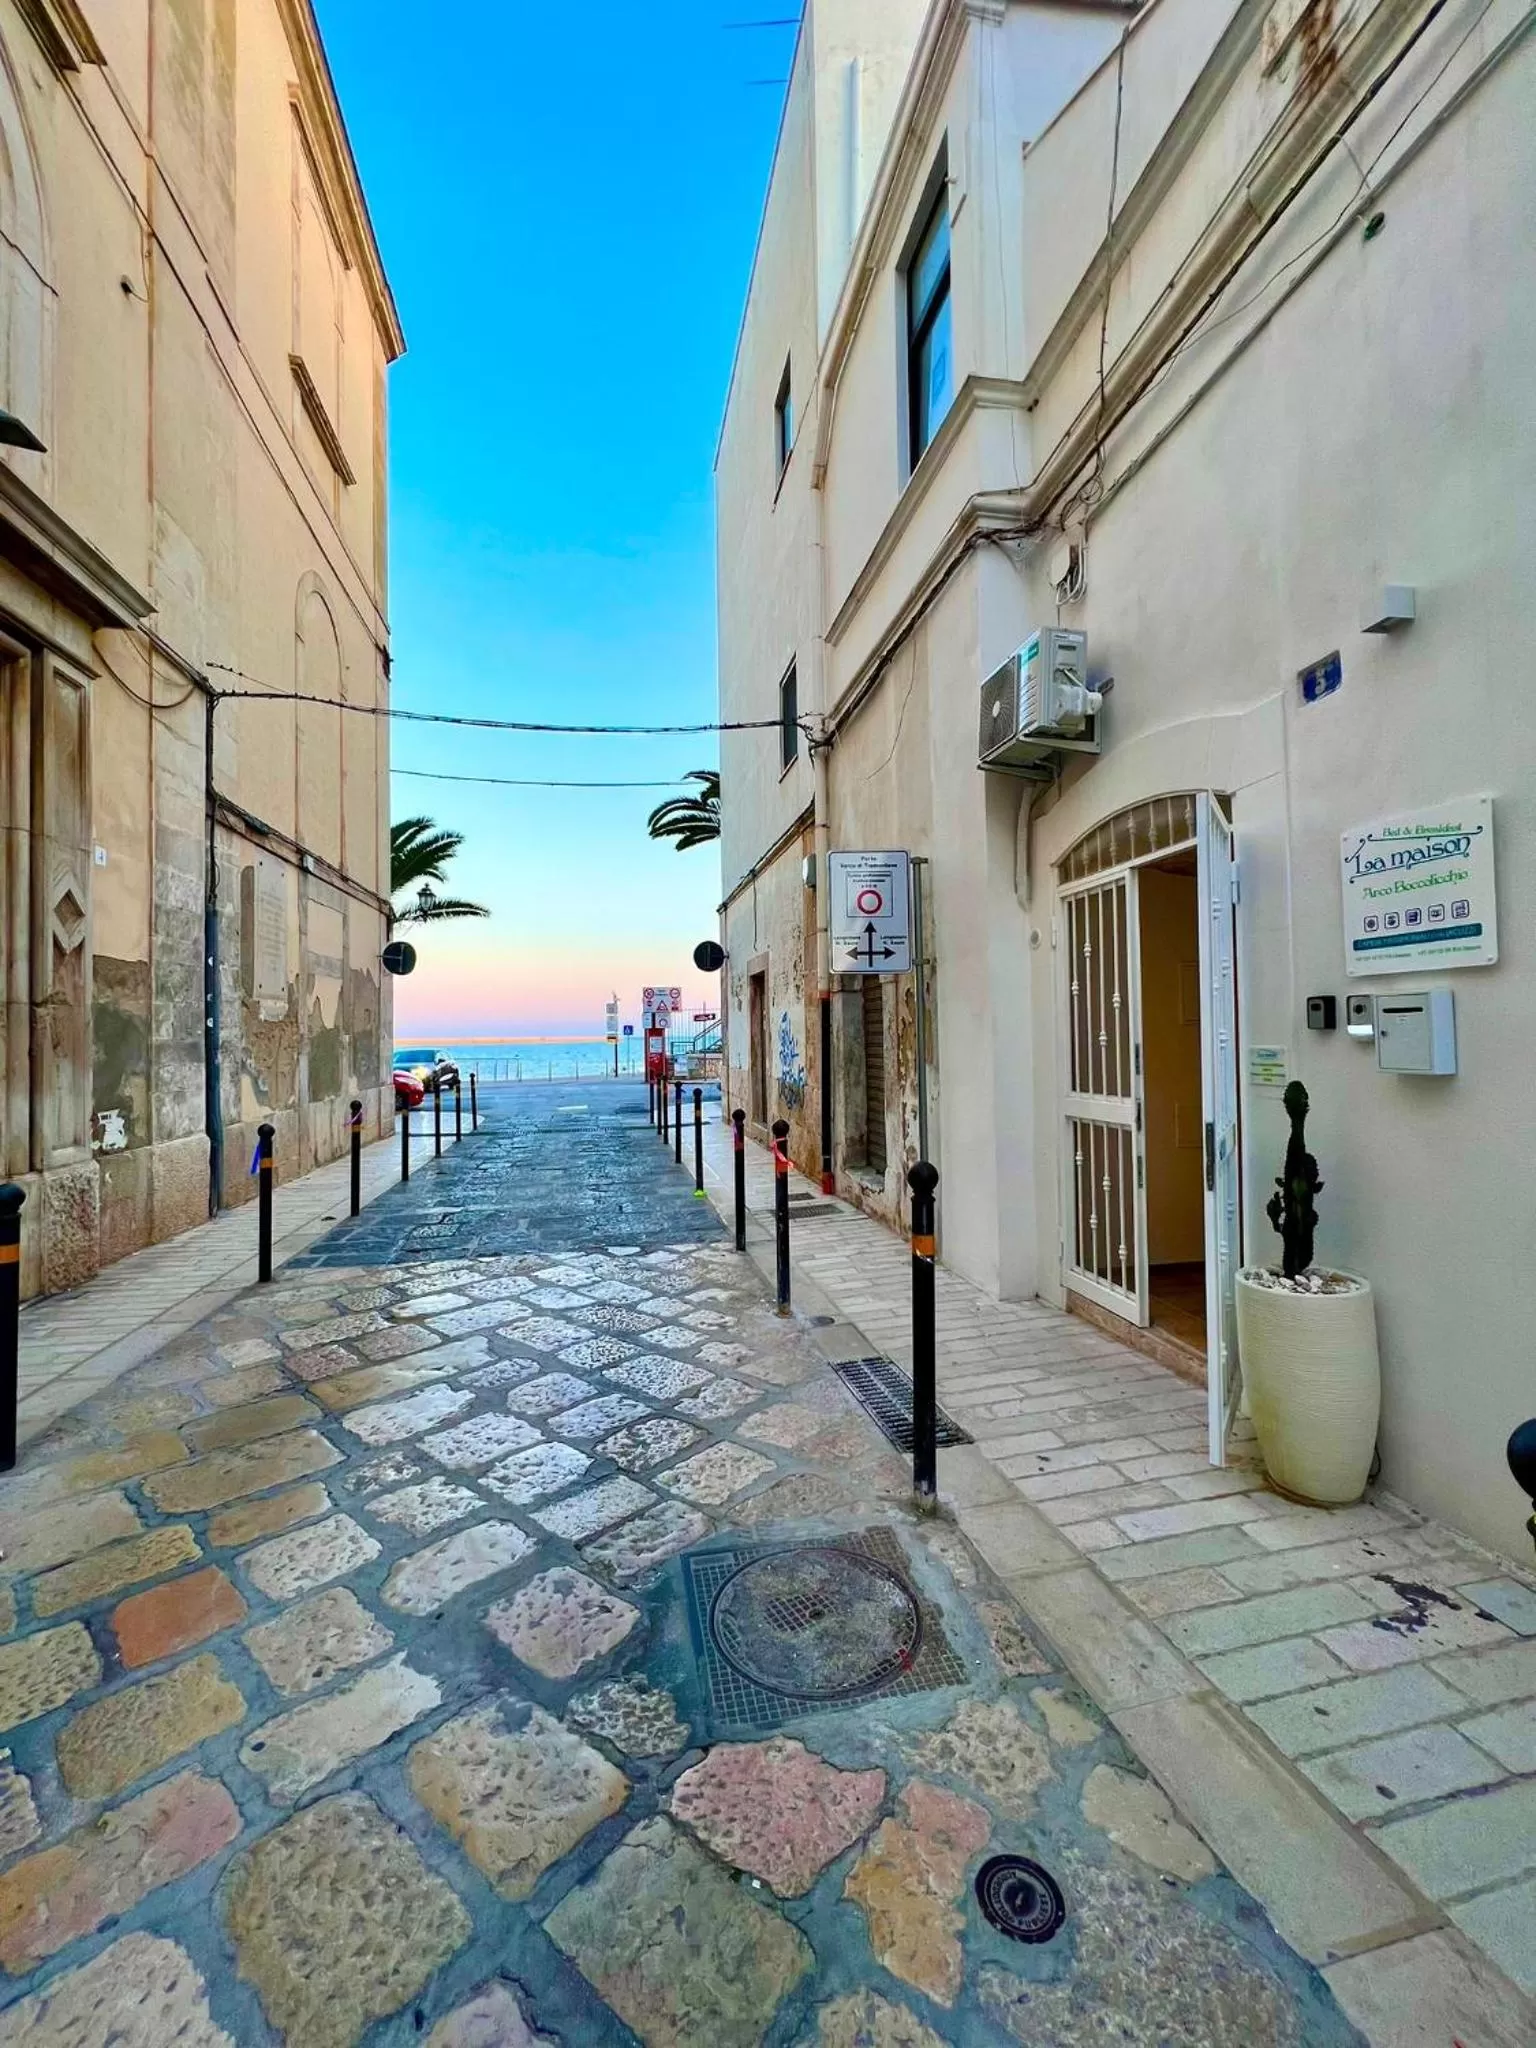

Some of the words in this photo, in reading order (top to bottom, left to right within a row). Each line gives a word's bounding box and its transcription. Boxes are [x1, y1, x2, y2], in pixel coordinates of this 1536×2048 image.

[1382, 826, 1401, 837] Bed
[1402, 825, 1412, 835] &
[1391, 836, 1471, 869] maison
[1362, 886, 1393, 900] Arco
